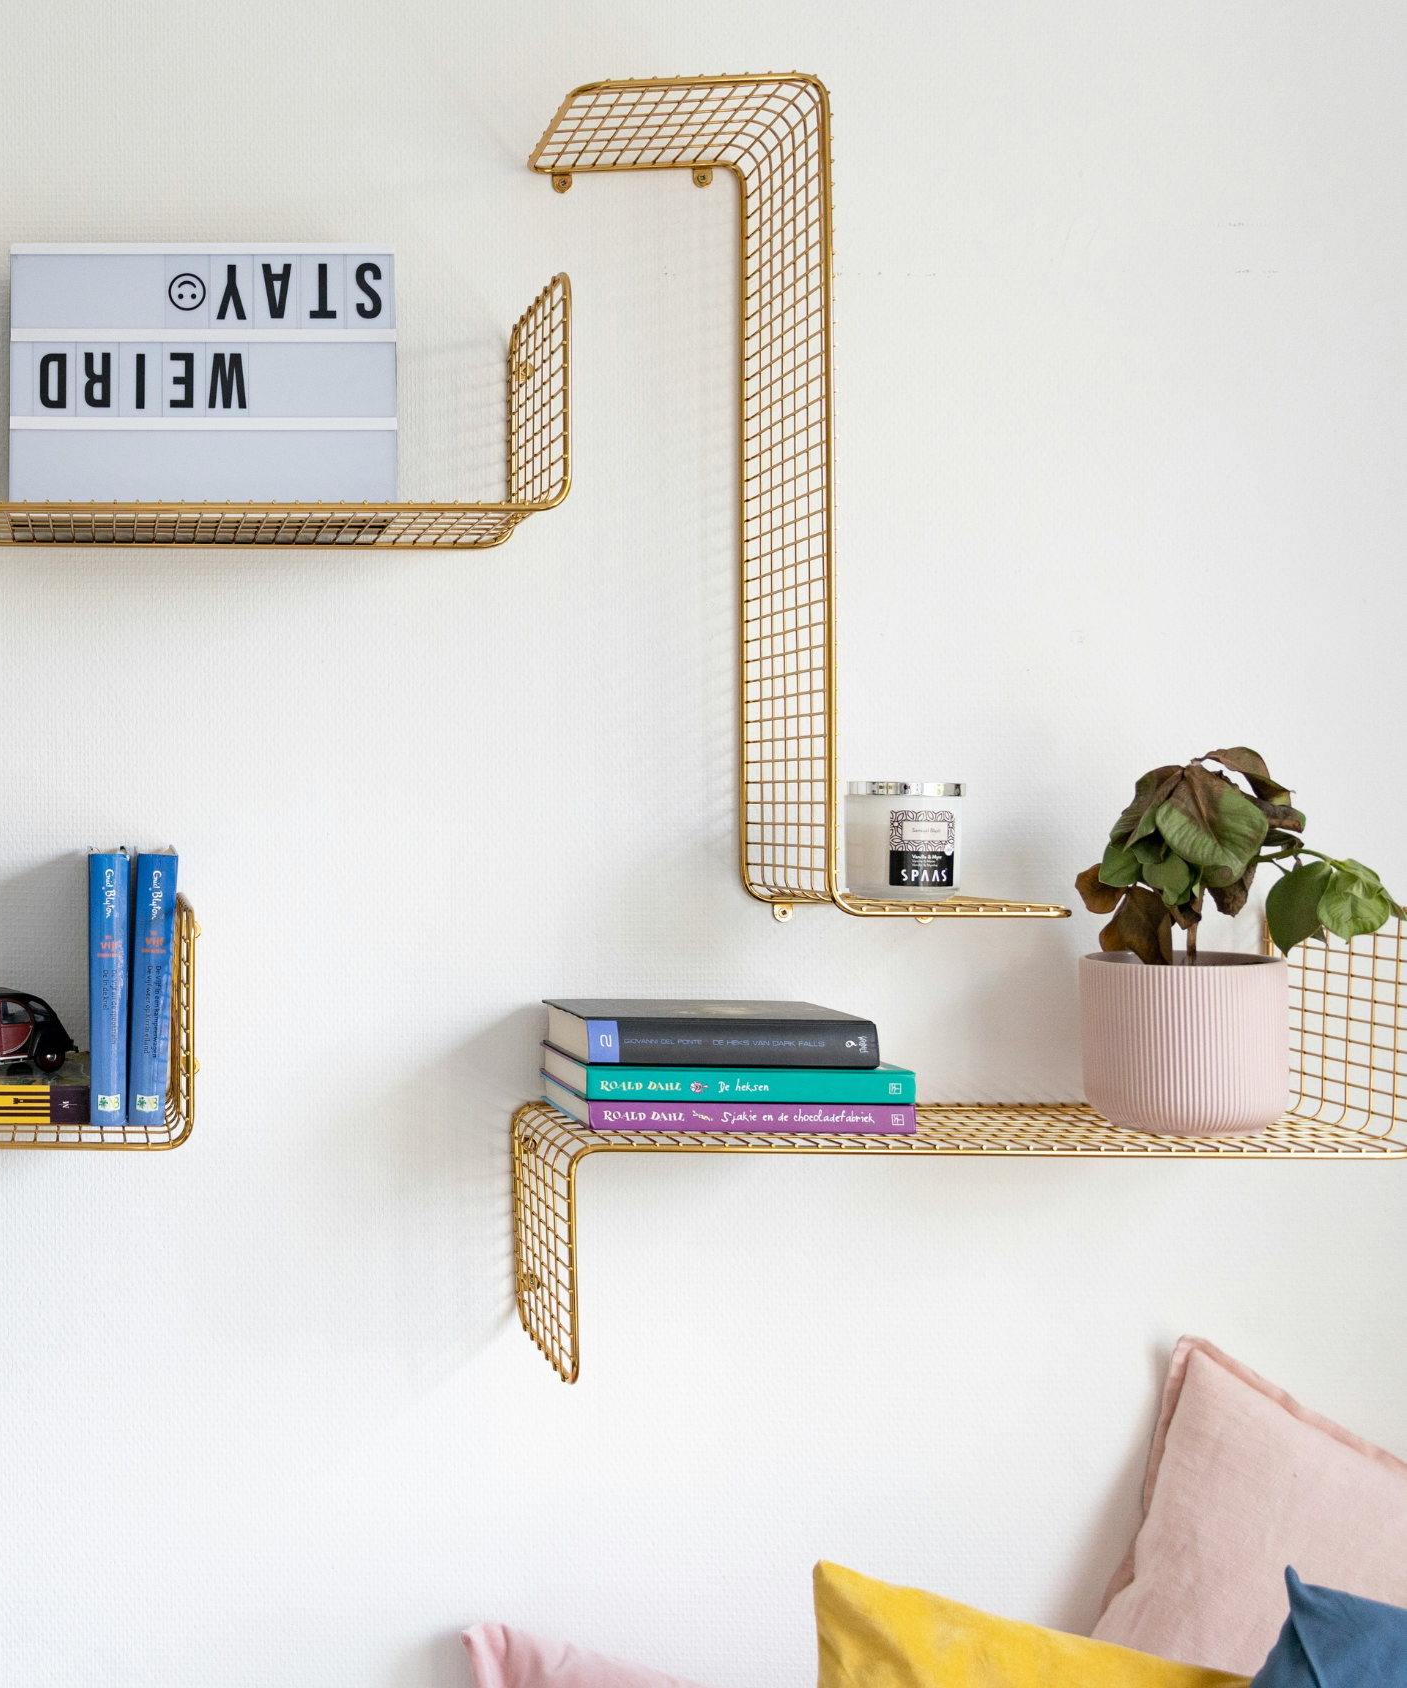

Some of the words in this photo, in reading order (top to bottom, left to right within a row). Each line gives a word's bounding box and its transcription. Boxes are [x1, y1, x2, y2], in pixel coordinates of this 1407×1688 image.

[216, 262, 382, 320] STAY
[39, 352, 247, 409] WEIRD
[900, 869, 947, 882] SPAAS
[102, 889, 116, 919] Blyton
[149, 891, 163, 920] Blyton
[103, 969, 109, 978] De
[147, 965, 153, 974] De
[156, 965, 162, 974] De
[145, 975, 153, 987] Vijf
[103, 987, 109, 996] de
[144, 1004, 150, 1013] op
[151, 1008, 160, 1058] kampeerwagen
[600, 1080, 643, 1091] ROALD
[647, 1081, 681, 1091] DAHL
[718, 1081, 730, 1093] De
[735, 1078, 769, 1092] heksen
[603, 1110, 646, 1122] ROALD
[651, 1111, 684, 1122] DAHL
[721, 1109, 757, 1124] Sjakie
[778, 1113, 789, 1122] de
[794, 1108, 875, 1124] chocoladefabriek
